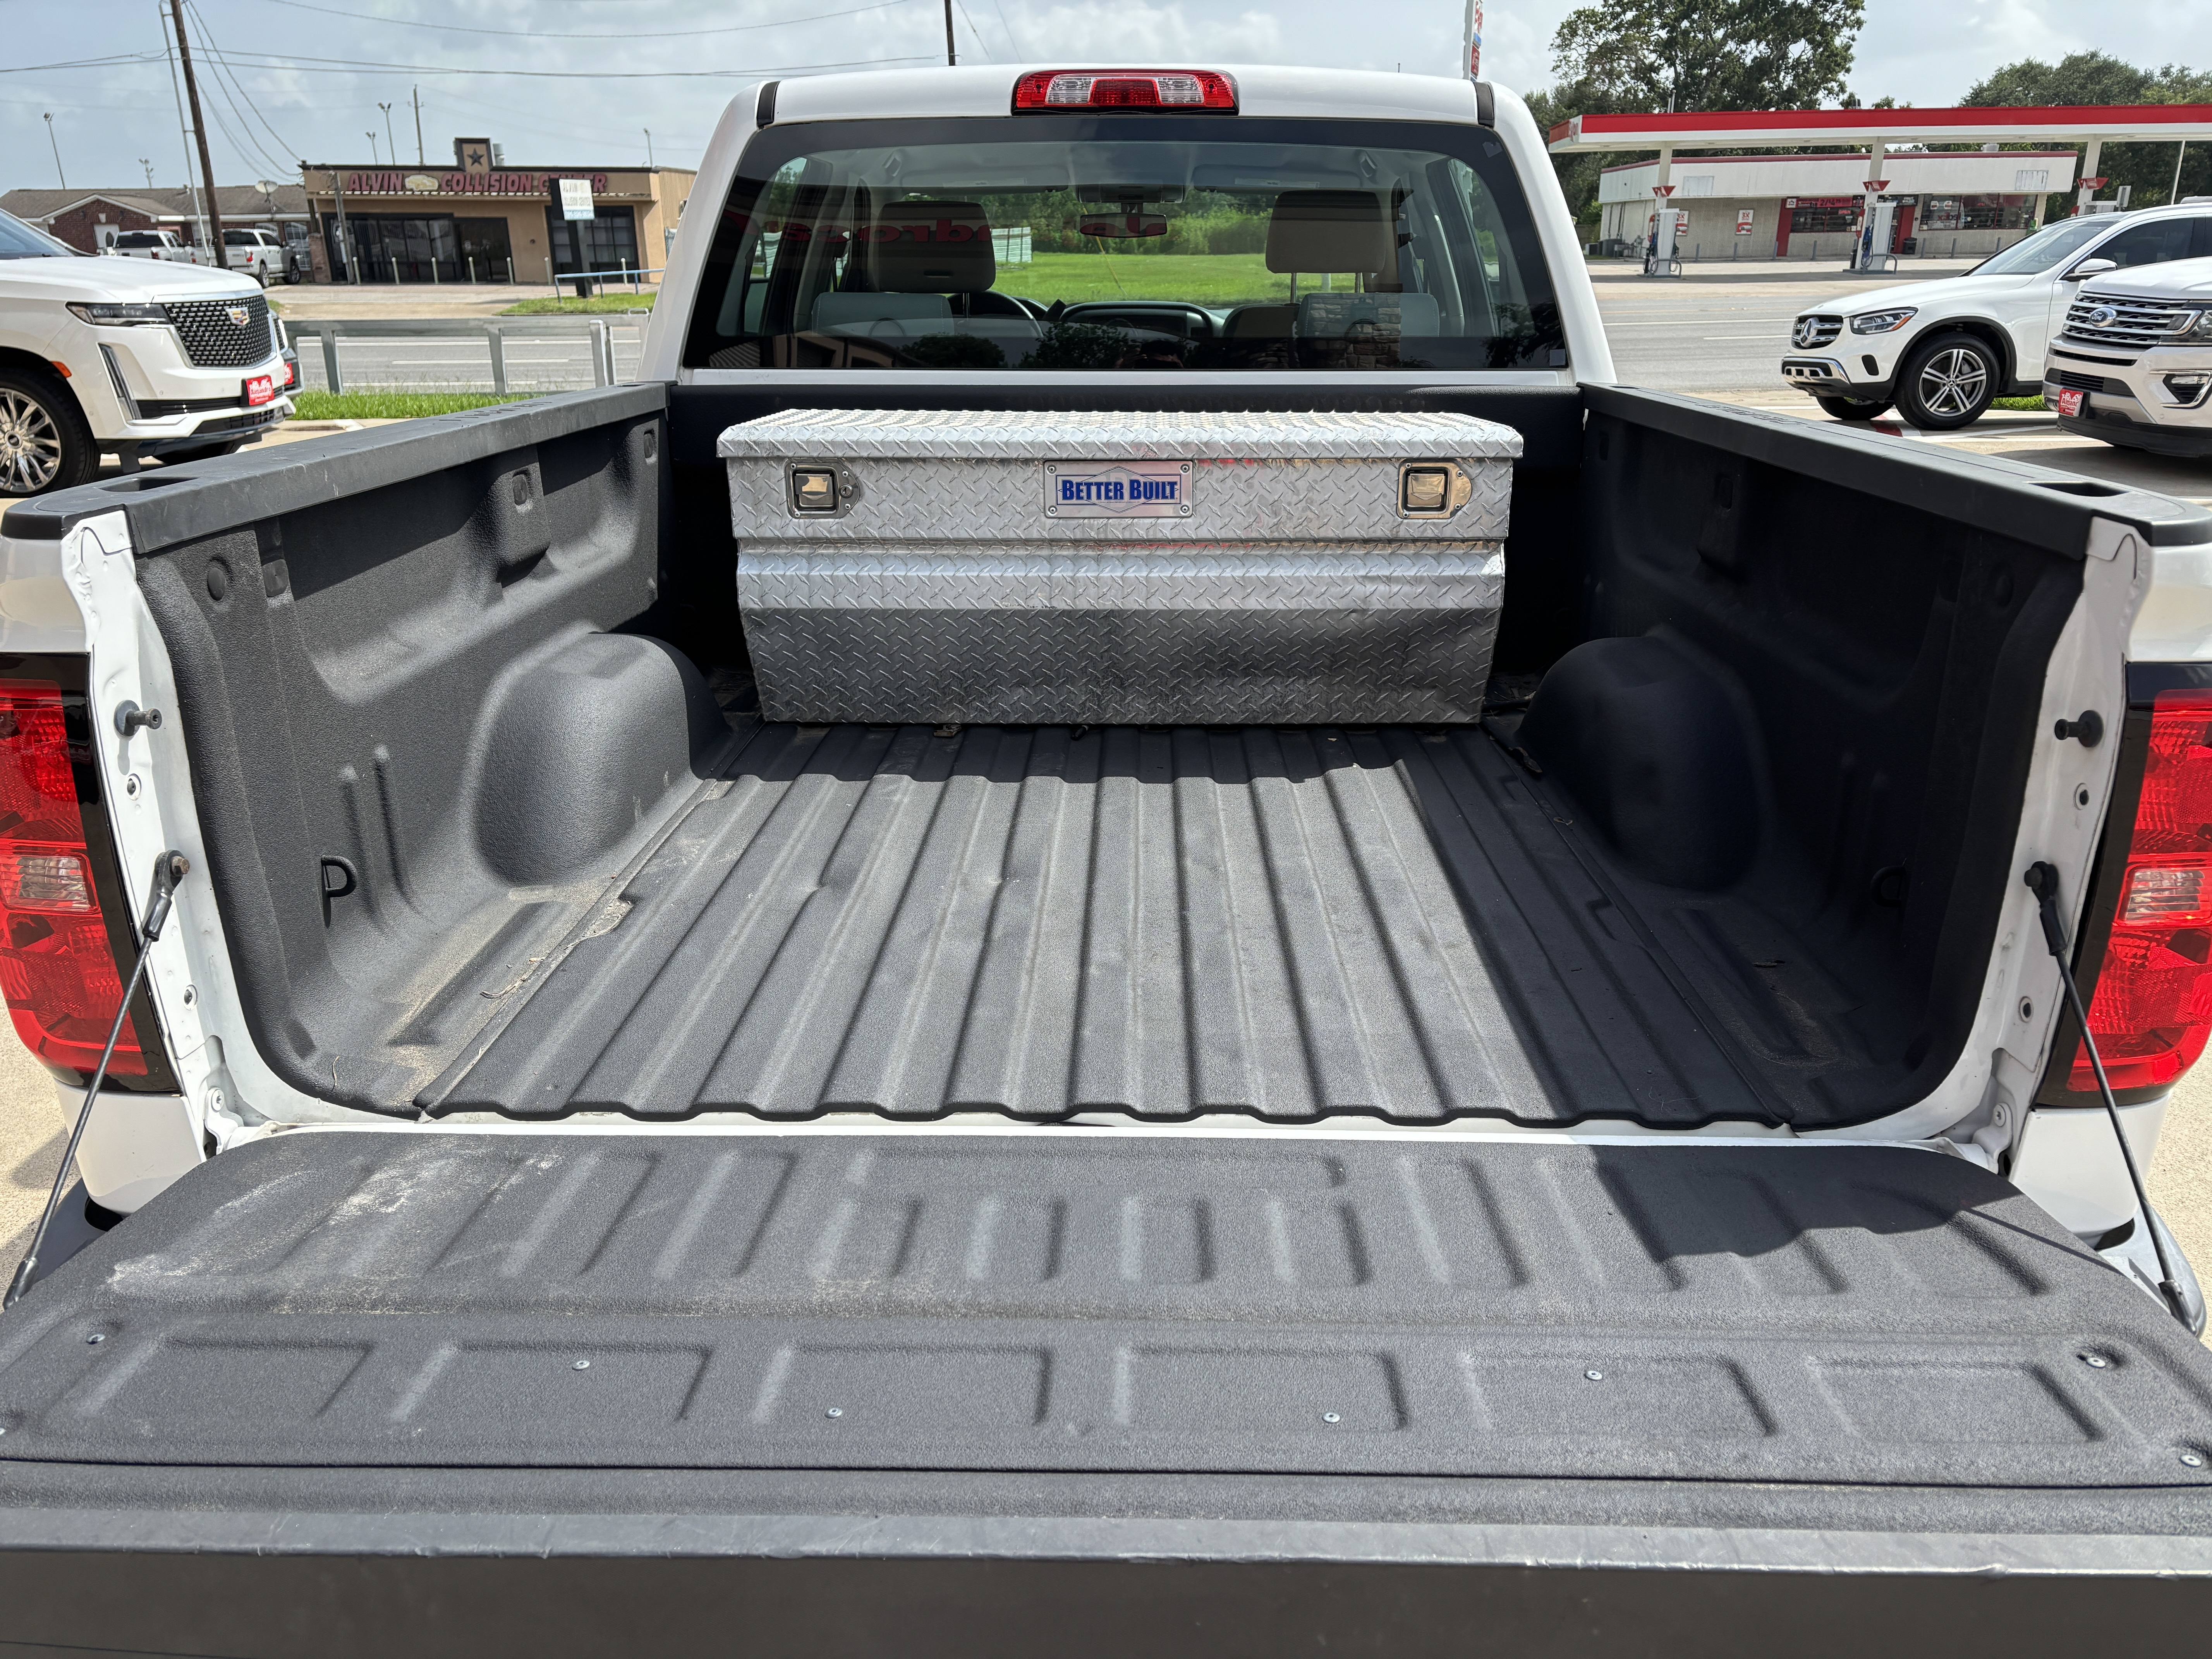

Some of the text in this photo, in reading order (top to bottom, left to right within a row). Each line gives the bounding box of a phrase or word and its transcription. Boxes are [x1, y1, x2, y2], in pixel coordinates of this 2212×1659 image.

[348, 172, 403, 192] ALVIN
[441, 173, 533, 193] COLLISION
[1062, 479, 1177, 500] BETTER BUILT
